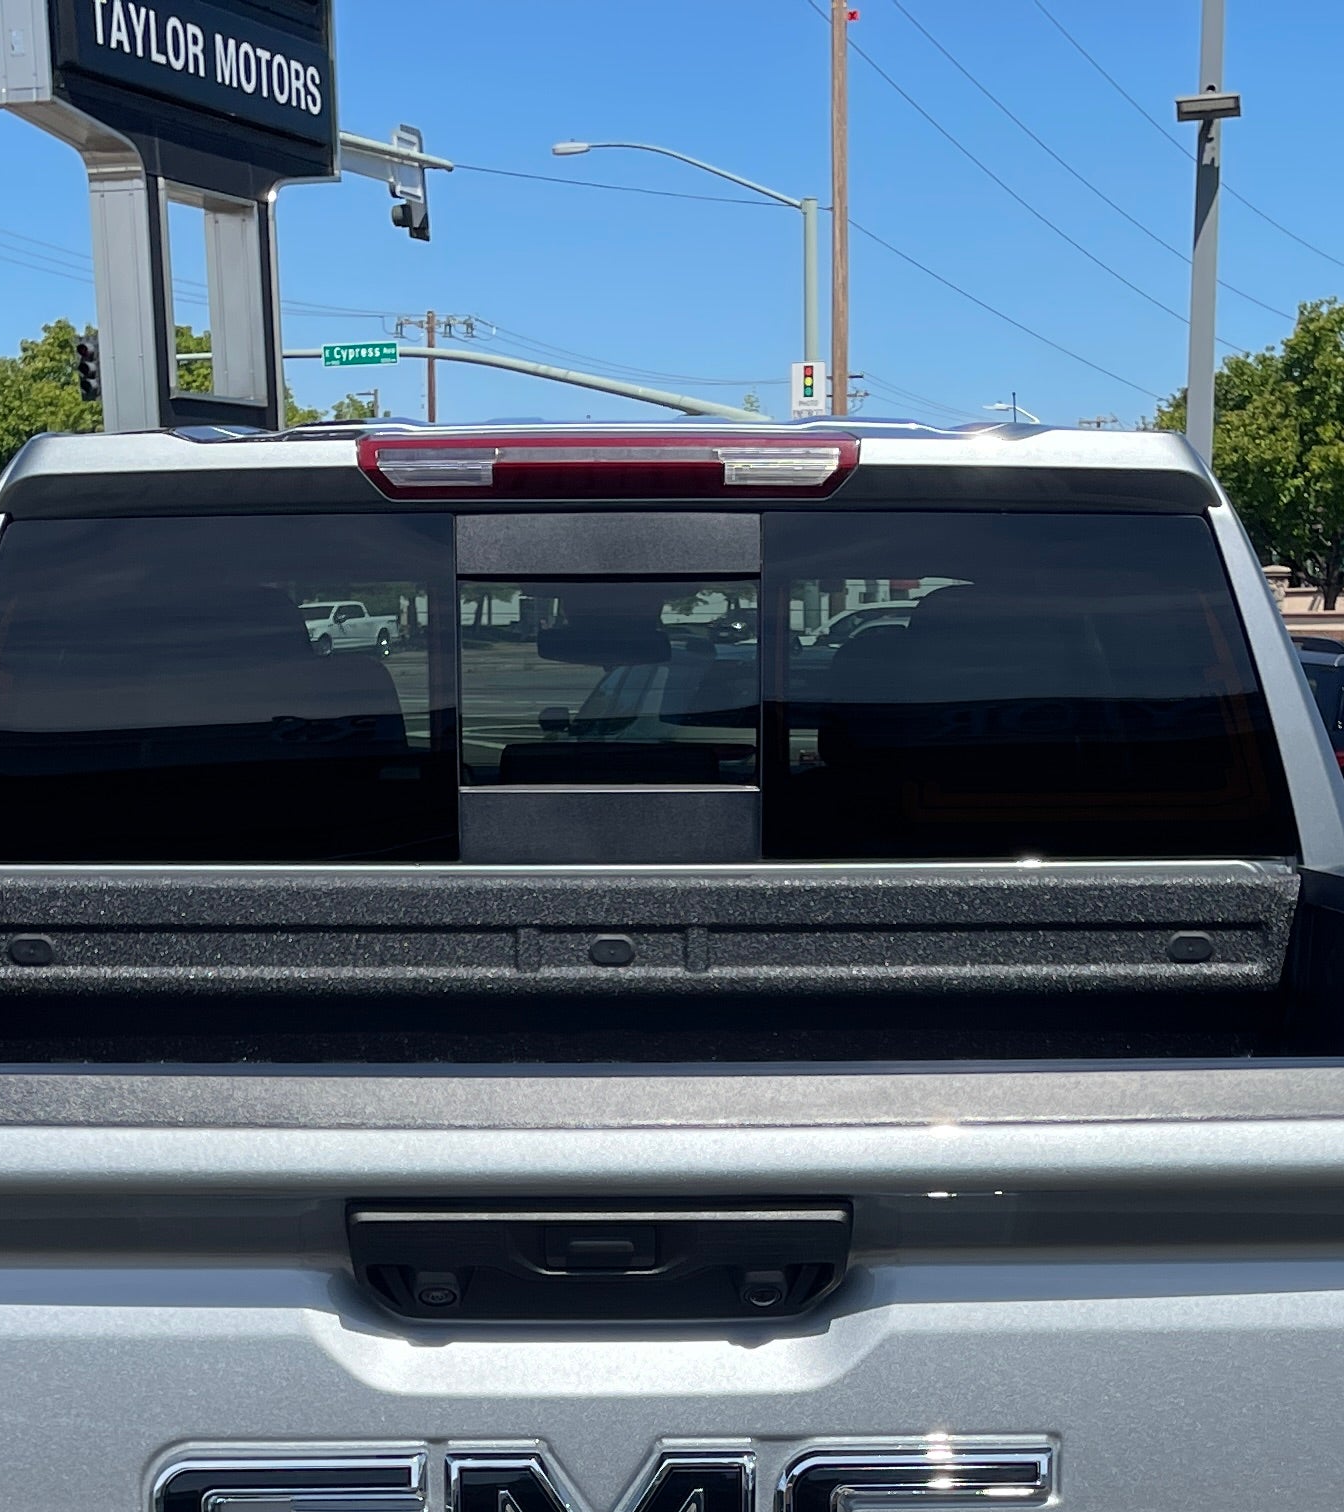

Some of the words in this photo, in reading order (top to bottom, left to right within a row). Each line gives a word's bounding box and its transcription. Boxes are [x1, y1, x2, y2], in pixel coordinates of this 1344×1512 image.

[93, 0, 206, 78] TAYLOR
[214, 33, 322, 116] MOTORS
[333, 346, 381, 362] Cypress
